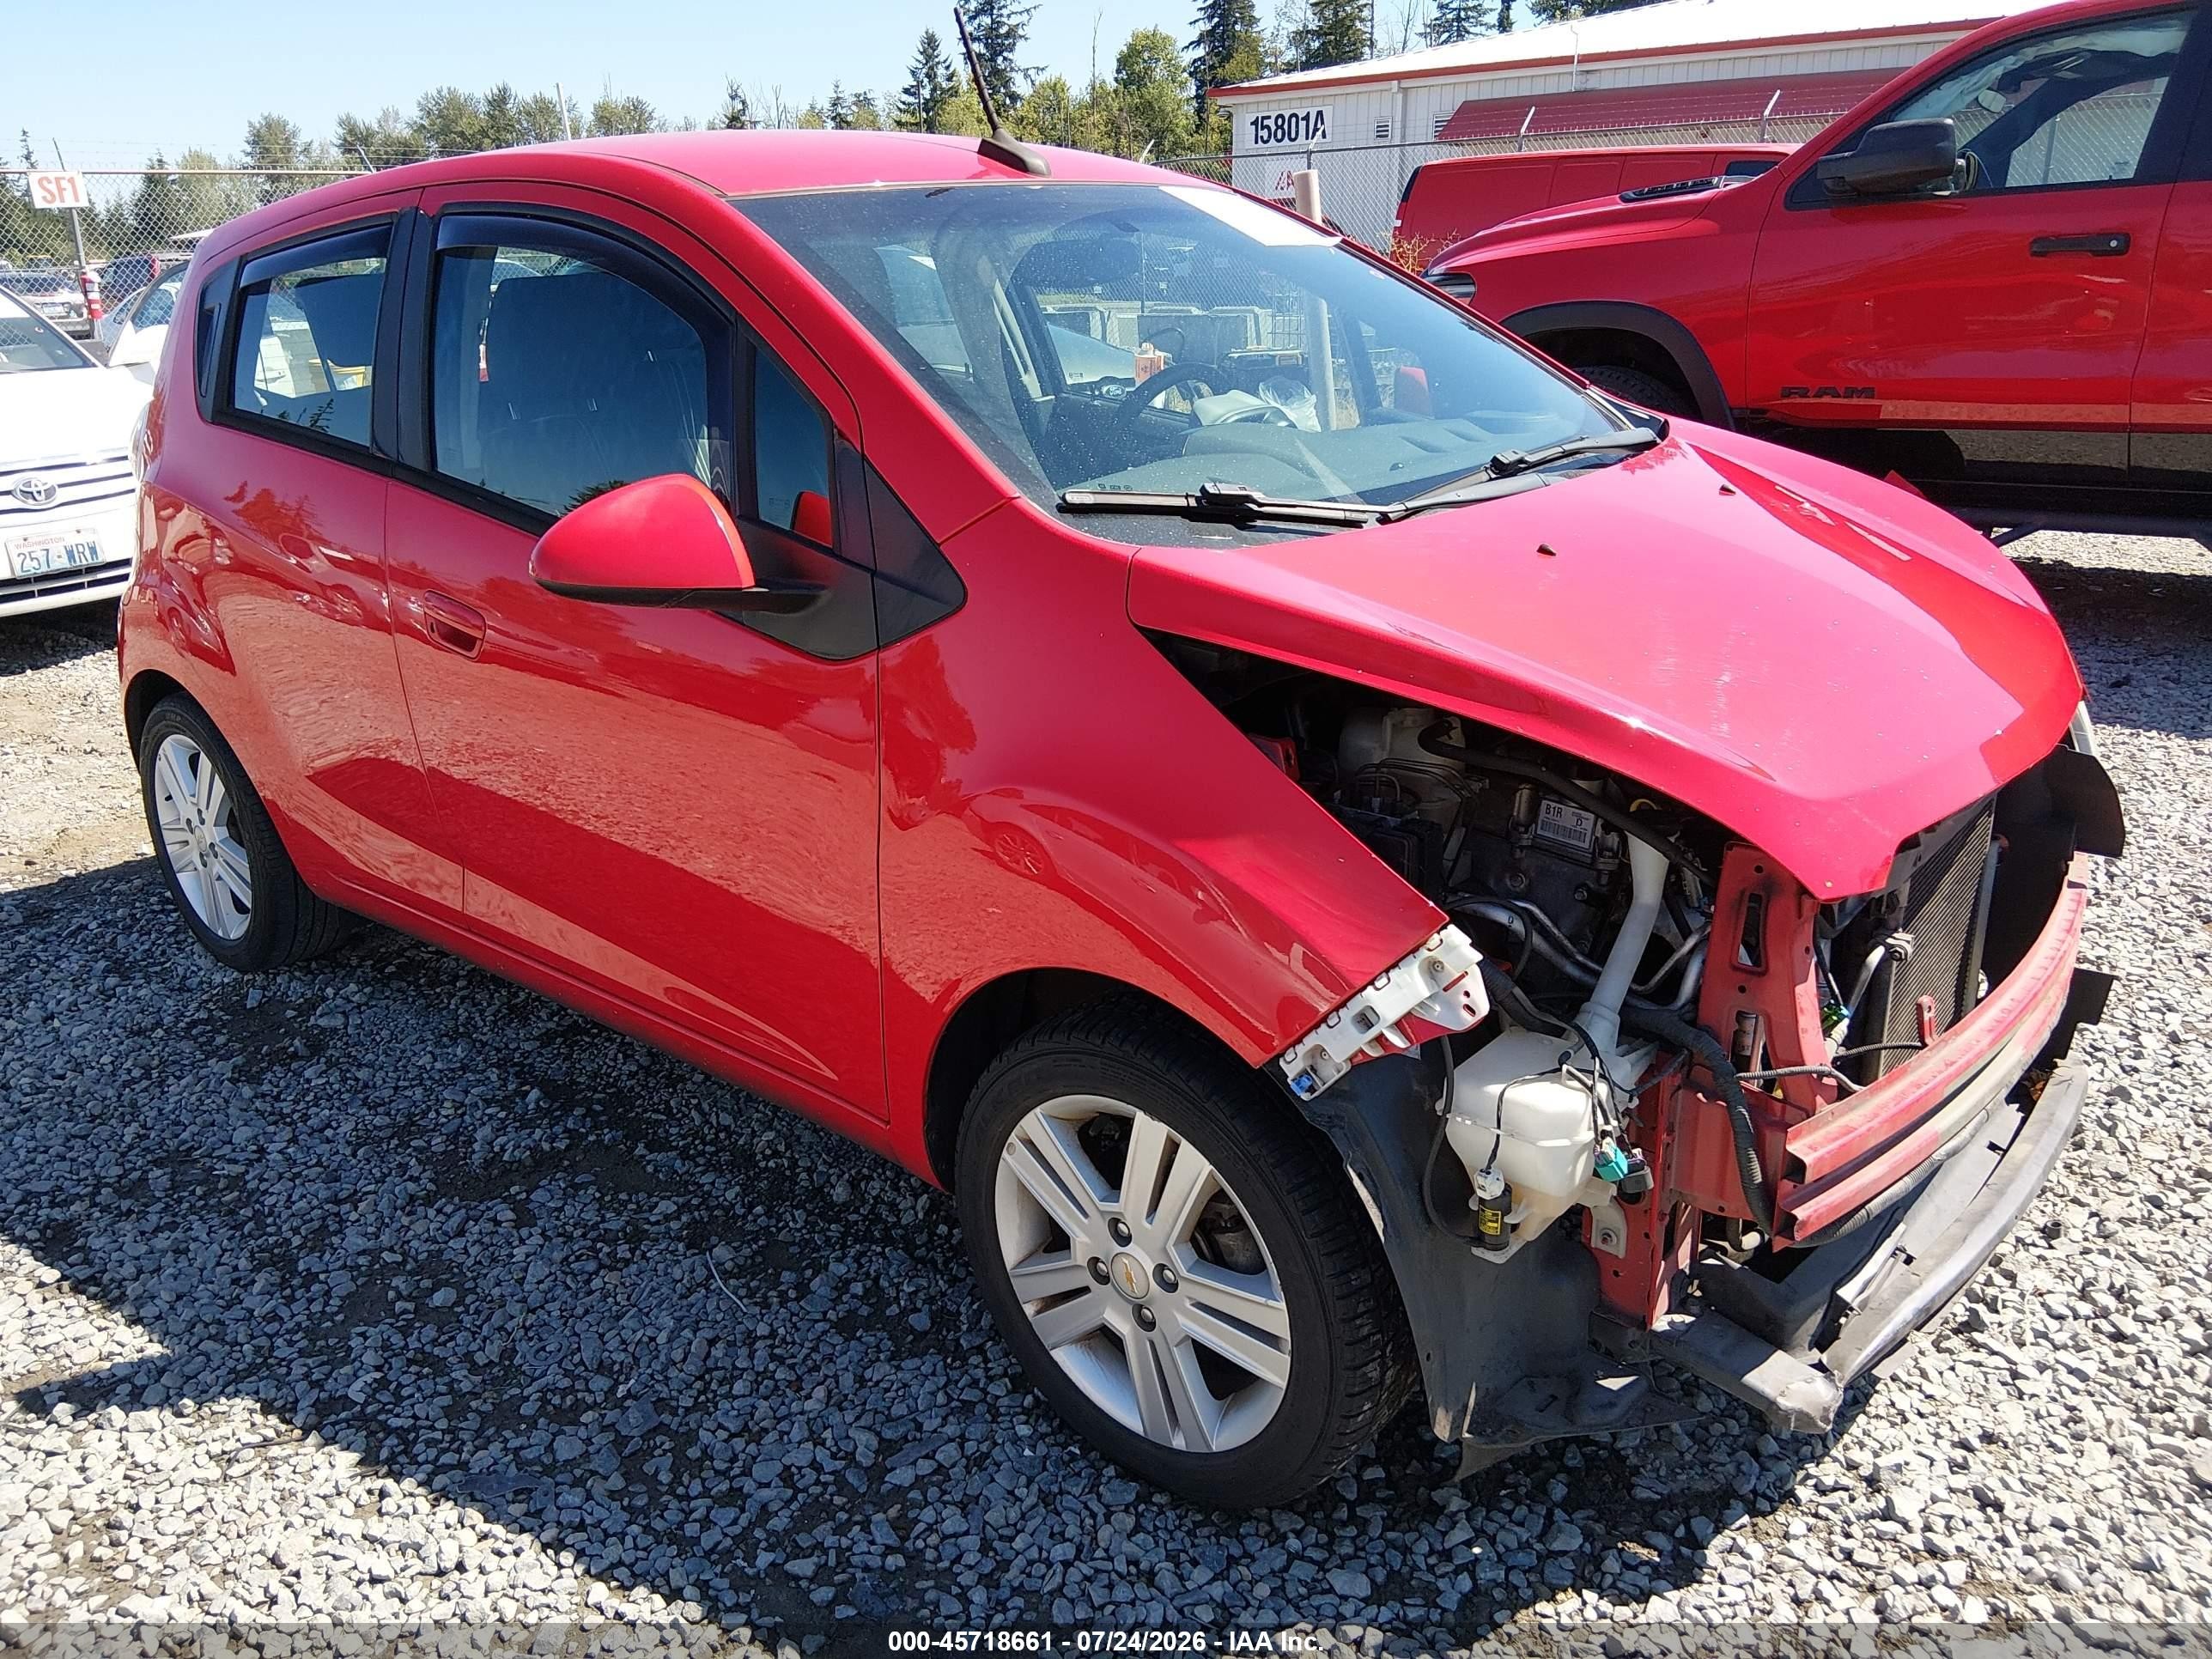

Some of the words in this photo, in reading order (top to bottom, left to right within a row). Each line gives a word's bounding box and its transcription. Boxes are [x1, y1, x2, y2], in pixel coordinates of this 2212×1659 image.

[1250, 110, 1327, 145] 15801A
[38, 176, 80, 204] SF1
[1780, 386, 1876, 399] RAM
[15, 537, 65, 550] WASHINGTON
[1546, 804, 1563, 818] B1R
[1576, 817, 1583, 827] D
